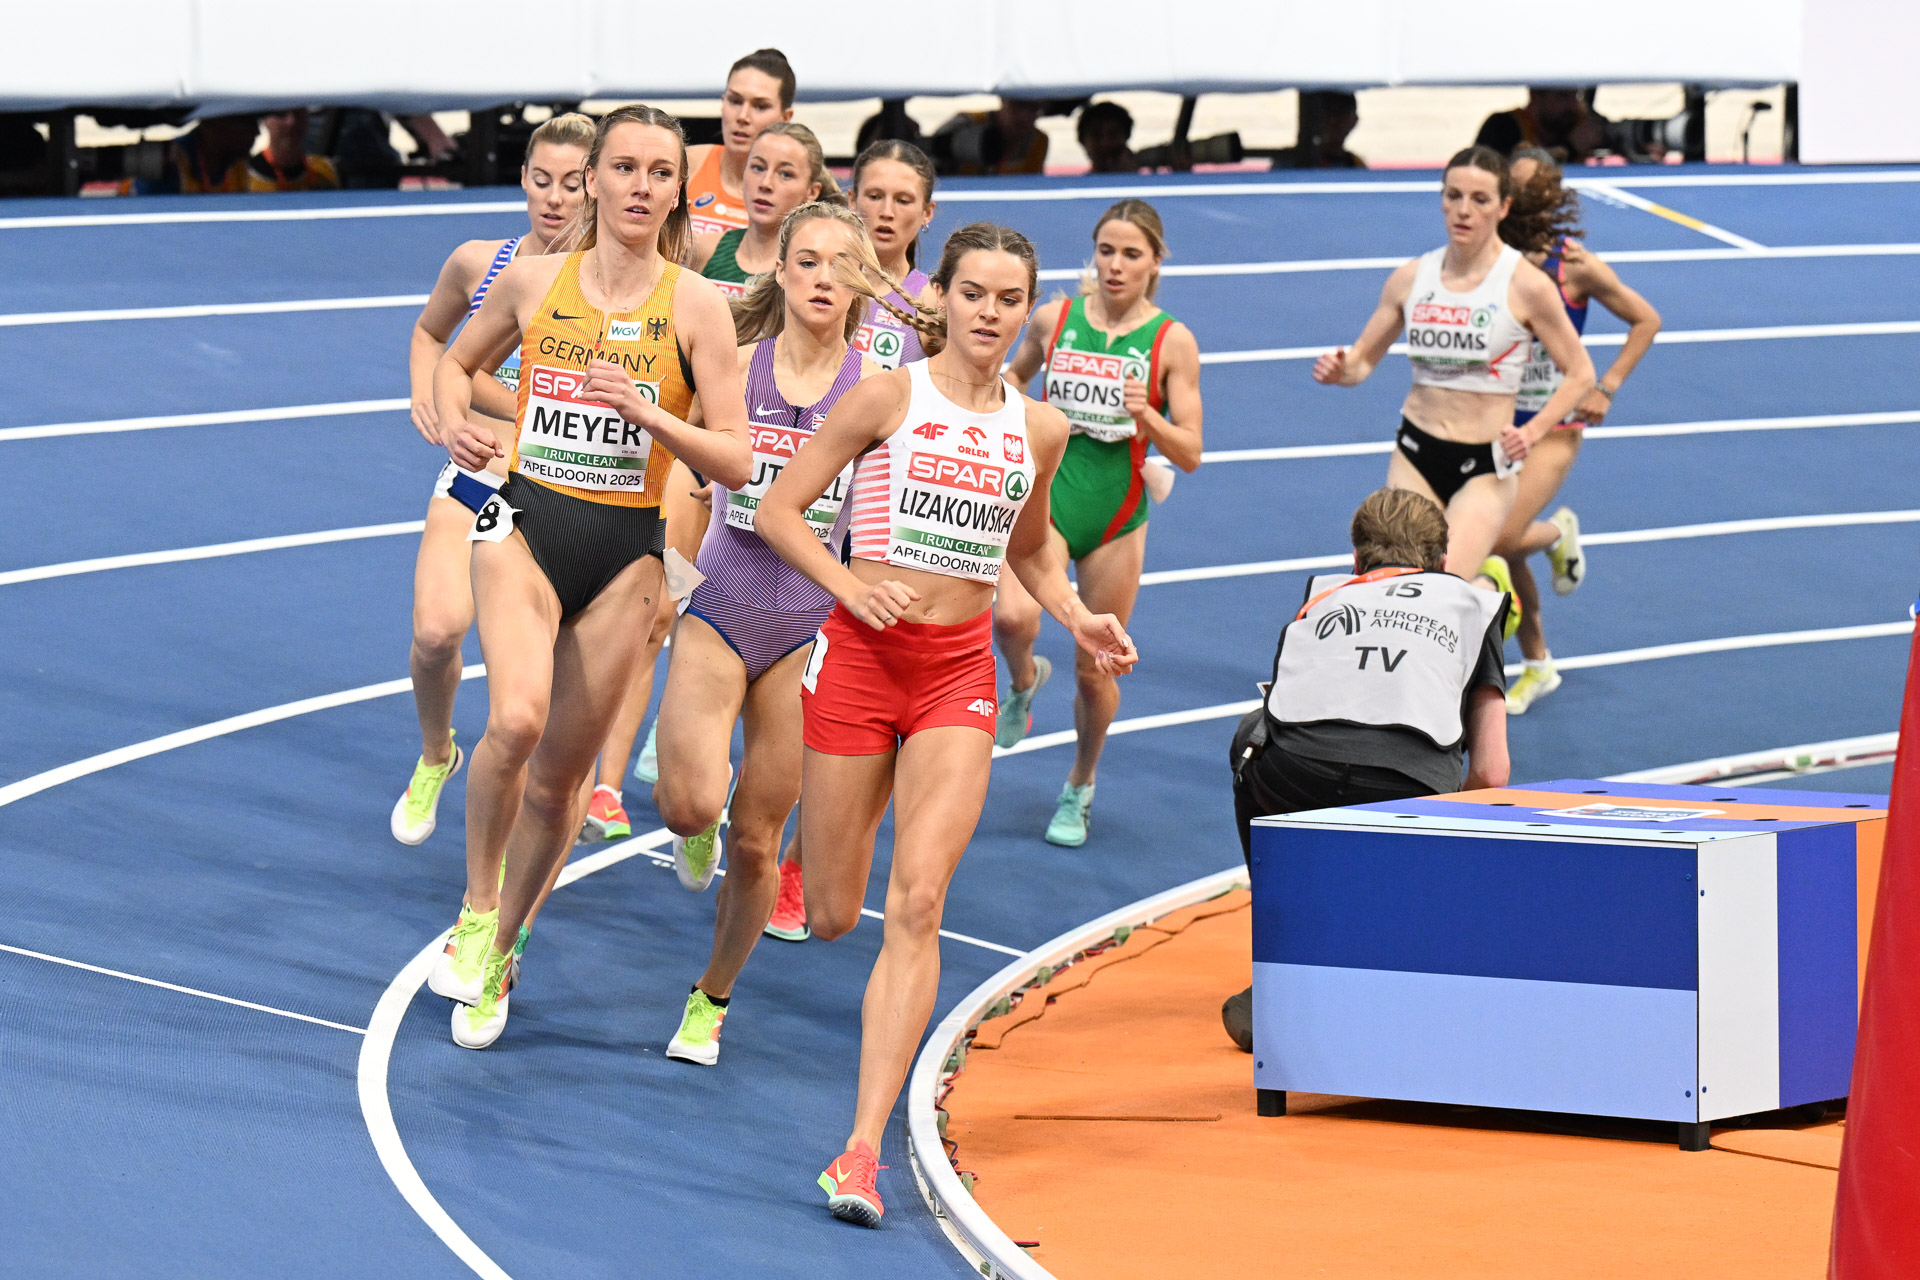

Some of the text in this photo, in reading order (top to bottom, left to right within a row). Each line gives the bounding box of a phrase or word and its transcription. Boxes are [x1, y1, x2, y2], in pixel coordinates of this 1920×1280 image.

[1413, 306, 1468, 325] SPAR
[611, 325, 641, 336] WGV
[1409, 329, 1486, 350] ROOMS
[539, 336, 657, 373] GERMANY
[1053, 354, 1119, 377] SPAR
[1049, 380, 1126, 408] AFONS
[532, 406, 642, 447] MEYER
[912, 421, 949, 440] 4F
[549, 450, 575, 462] RUN
[957, 445, 990, 459] ORLEN
[523, 460, 642, 486] APELDOORN 2025
[912, 455, 1000, 492] SPAR
[476, 501, 501, 533] 8
[898, 487, 1016, 535] LIZAKOWSKA
[926, 535, 954, 549] RUN
[893, 545, 1001, 576] APELDOORN 202
[1381, 582, 1424, 598] 15
[1370, 619, 1456, 654] ATHLETICS
[1373, 609, 1459, 644] EUROPEAN
[1355, 646, 1408, 673] TV
[967, 698, 994, 717] 4F
